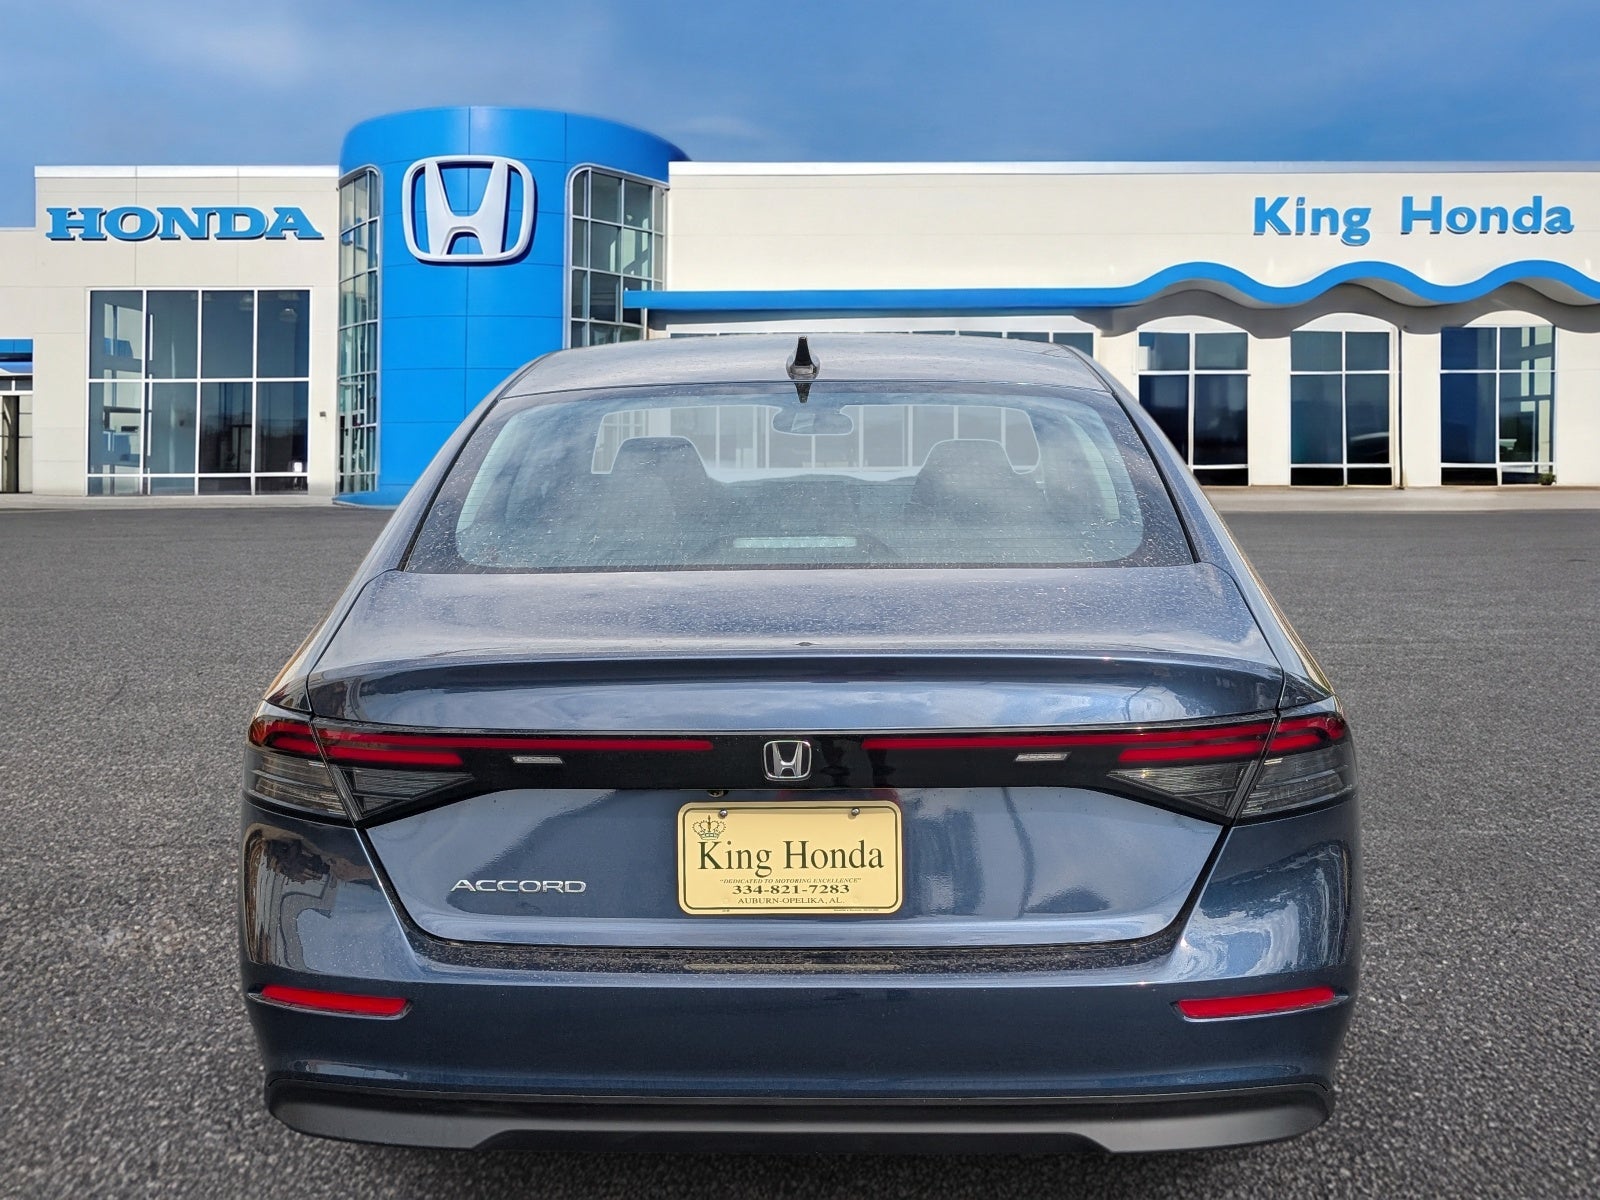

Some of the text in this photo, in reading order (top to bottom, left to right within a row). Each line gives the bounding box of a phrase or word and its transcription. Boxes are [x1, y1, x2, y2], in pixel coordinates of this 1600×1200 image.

[45, 206, 324, 241] HONDA
[1253, 195, 1575, 246] King Honda
[697, 839, 885, 878] King Honda
[450, 879, 587, 893] ACCORD
[732, 884, 850, 895] 334-821-7283
